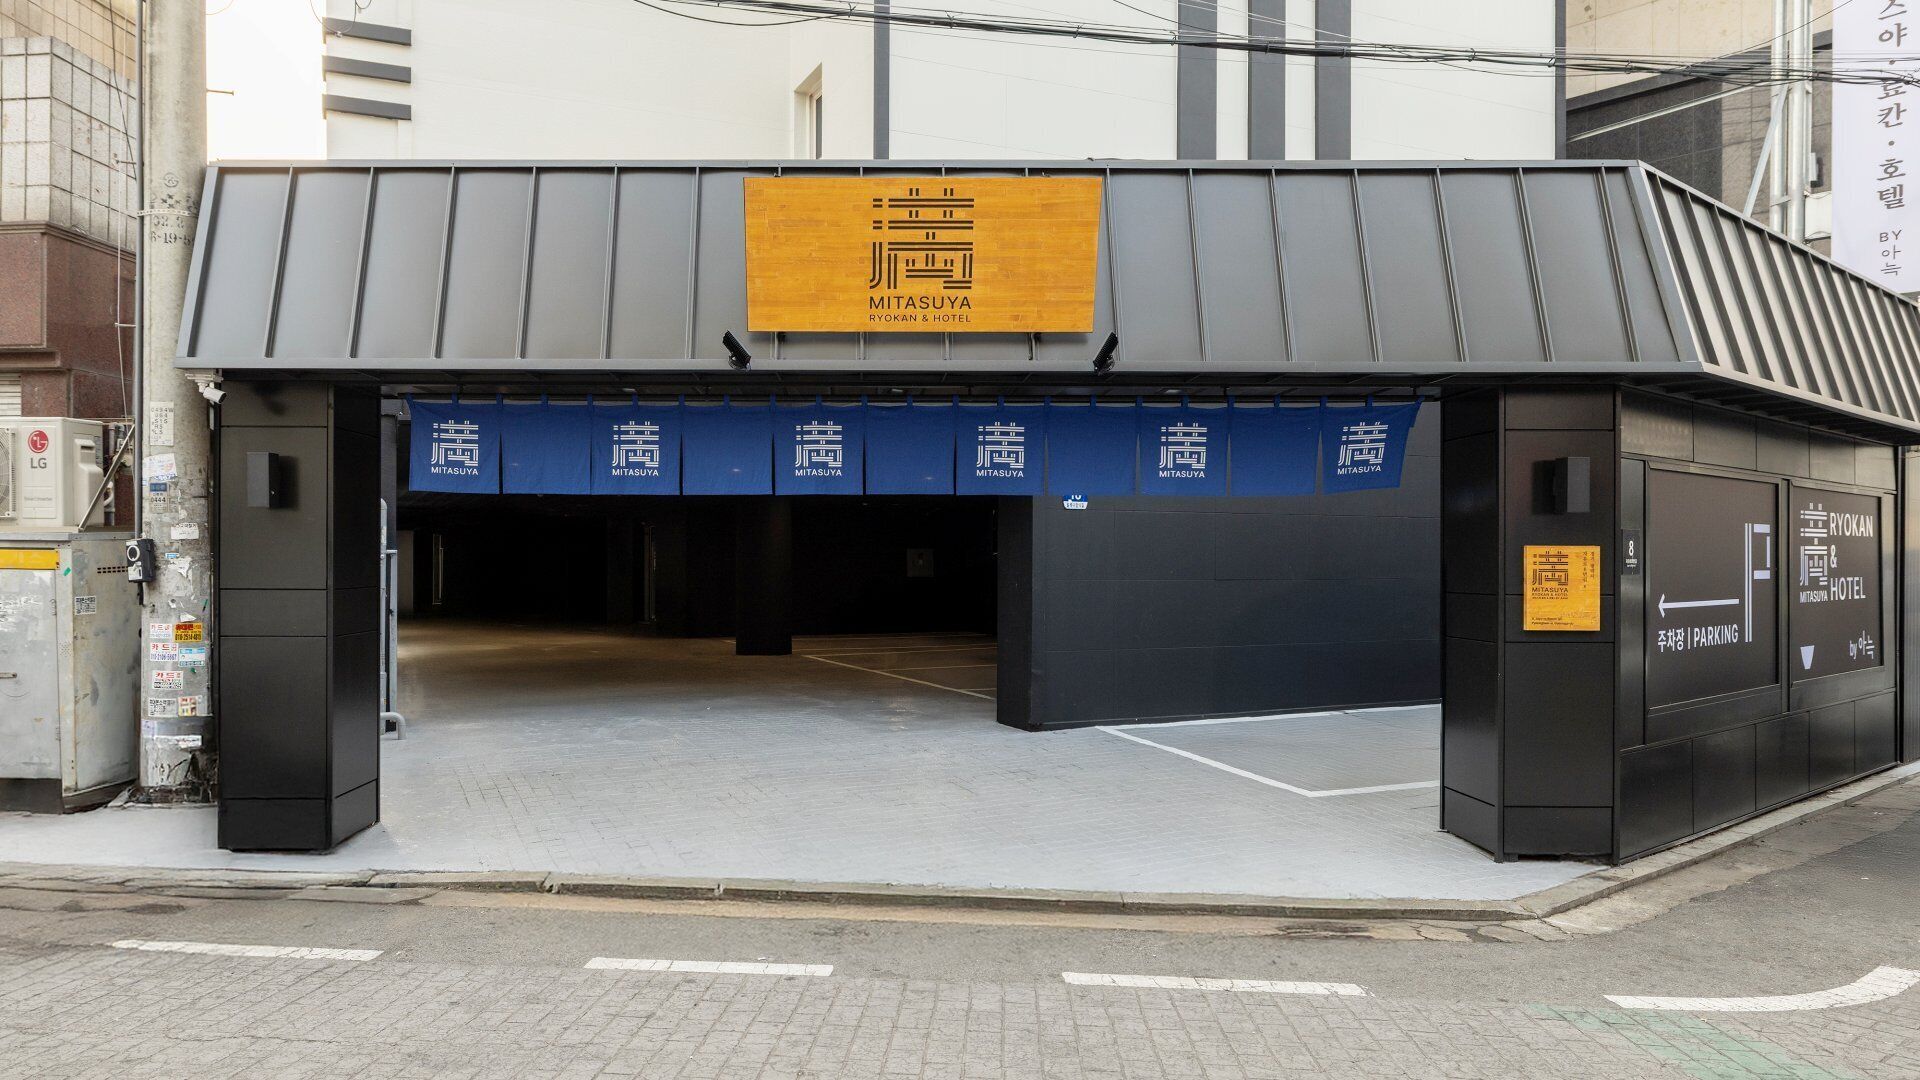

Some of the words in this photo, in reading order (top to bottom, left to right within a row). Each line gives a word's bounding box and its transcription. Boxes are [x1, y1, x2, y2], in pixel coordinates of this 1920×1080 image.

[1877, 158, 1907, 210] 호텔
[1879, 229, 1902, 243] BY
[1880, 245, 1902, 276] 아늑
[869, 296, 972, 310] MITASUYA
[869, 314, 917, 323] RYOKAN
[922, 314, 929, 323] &
[933, 314, 972, 323] HOTEL
[30, 458, 47, 469] LG
[1337, 465, 1382, 475] MITASUYA
[431, 466, 479, 476] MITASUYA
[612, 468, 659, 477] MITASUYA
[795, 468, 842, 477] MITASUYA
[976, 469, 1024, 478] MITASUYA
[1159, 470, 1206, 478] MITASUYA
[1830, 513, 1873, 537] RYOKAN
[1628, 540, 1634, 557] 8
[1830, 545, 1837, 568] &
[1830, 577, 1866, 600] HOTEL
[1800, 591, 1828, 604] MITASUYA
[1658, 630, 1684, 653] 주차장
[1694, 624, 1739, 648] PARKING
[1849, 640, 1857, 660] by
[1858, 630, 1875, 659] 아늑
